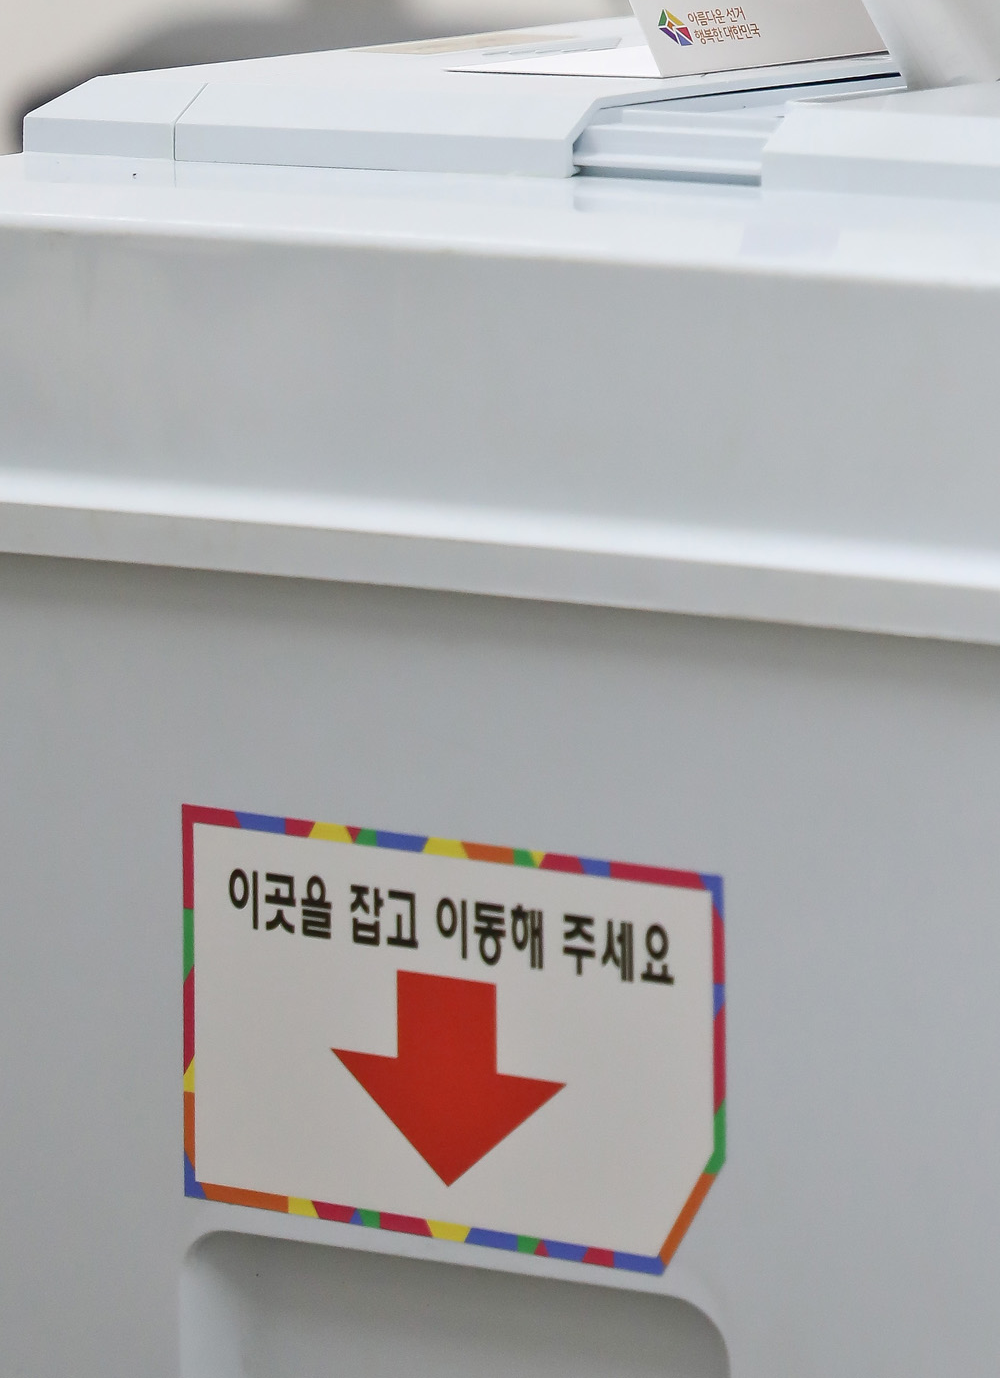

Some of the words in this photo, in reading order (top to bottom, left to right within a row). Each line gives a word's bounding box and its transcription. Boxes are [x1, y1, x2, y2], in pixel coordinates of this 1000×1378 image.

[687, 8, 725, 26] 아름다운
[726, 6, 747, 23] 선거
[693, 26, 724, 45] 행복한
[724, 23, 761, 40] 대한민국
[228, 868, 332, 940] 이곳을
[349, 884, 419, 950] 잡고
[436, 896, 544, 971] 이동해
[562, 913, 675, 986] 주세요
